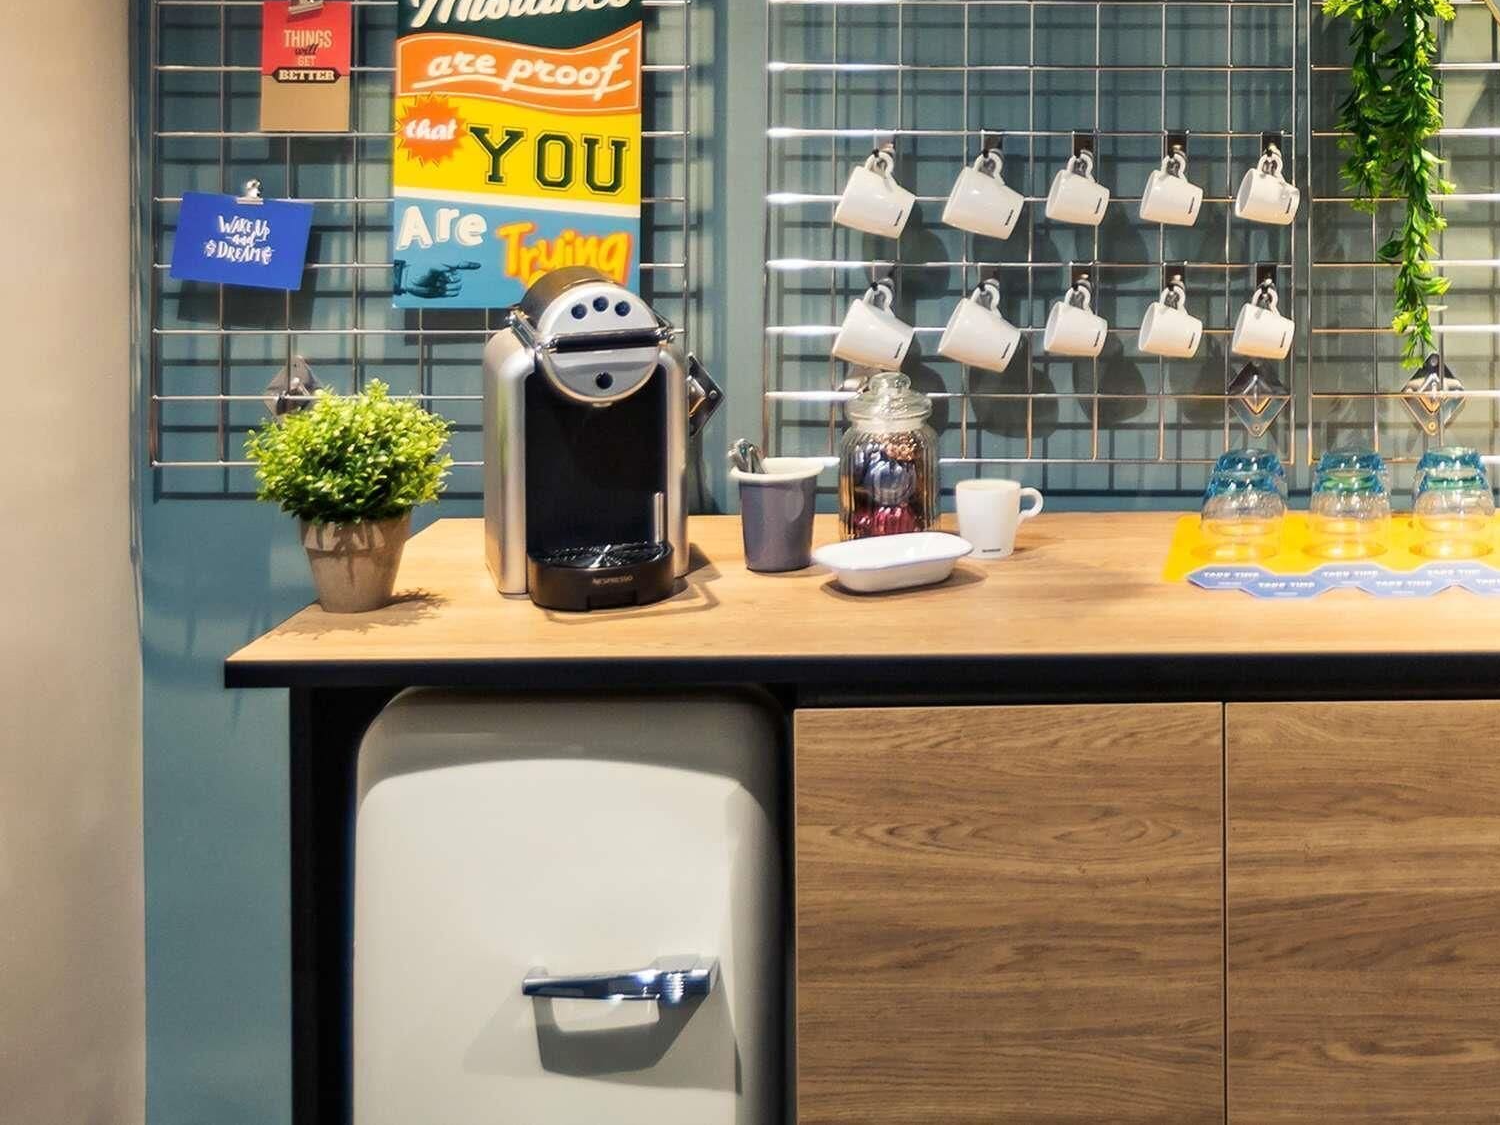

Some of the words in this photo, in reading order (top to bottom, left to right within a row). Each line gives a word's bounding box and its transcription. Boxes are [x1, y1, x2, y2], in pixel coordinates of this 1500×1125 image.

[283, 29, 333, 49] THINGS
[278, 69, 335, 81] BETTER
[427, 50, 497, 79] are
[503, 48, 630, 102] proof
[405, 119, 456, 142] that
[467, 124, 631, 196] YOU
[217, 215, 254, 235] WAKE
[216, 241, 261, 263] DREAM
[395, 205, 487, 251] Are
[496, 221, 632, 292] Trying
